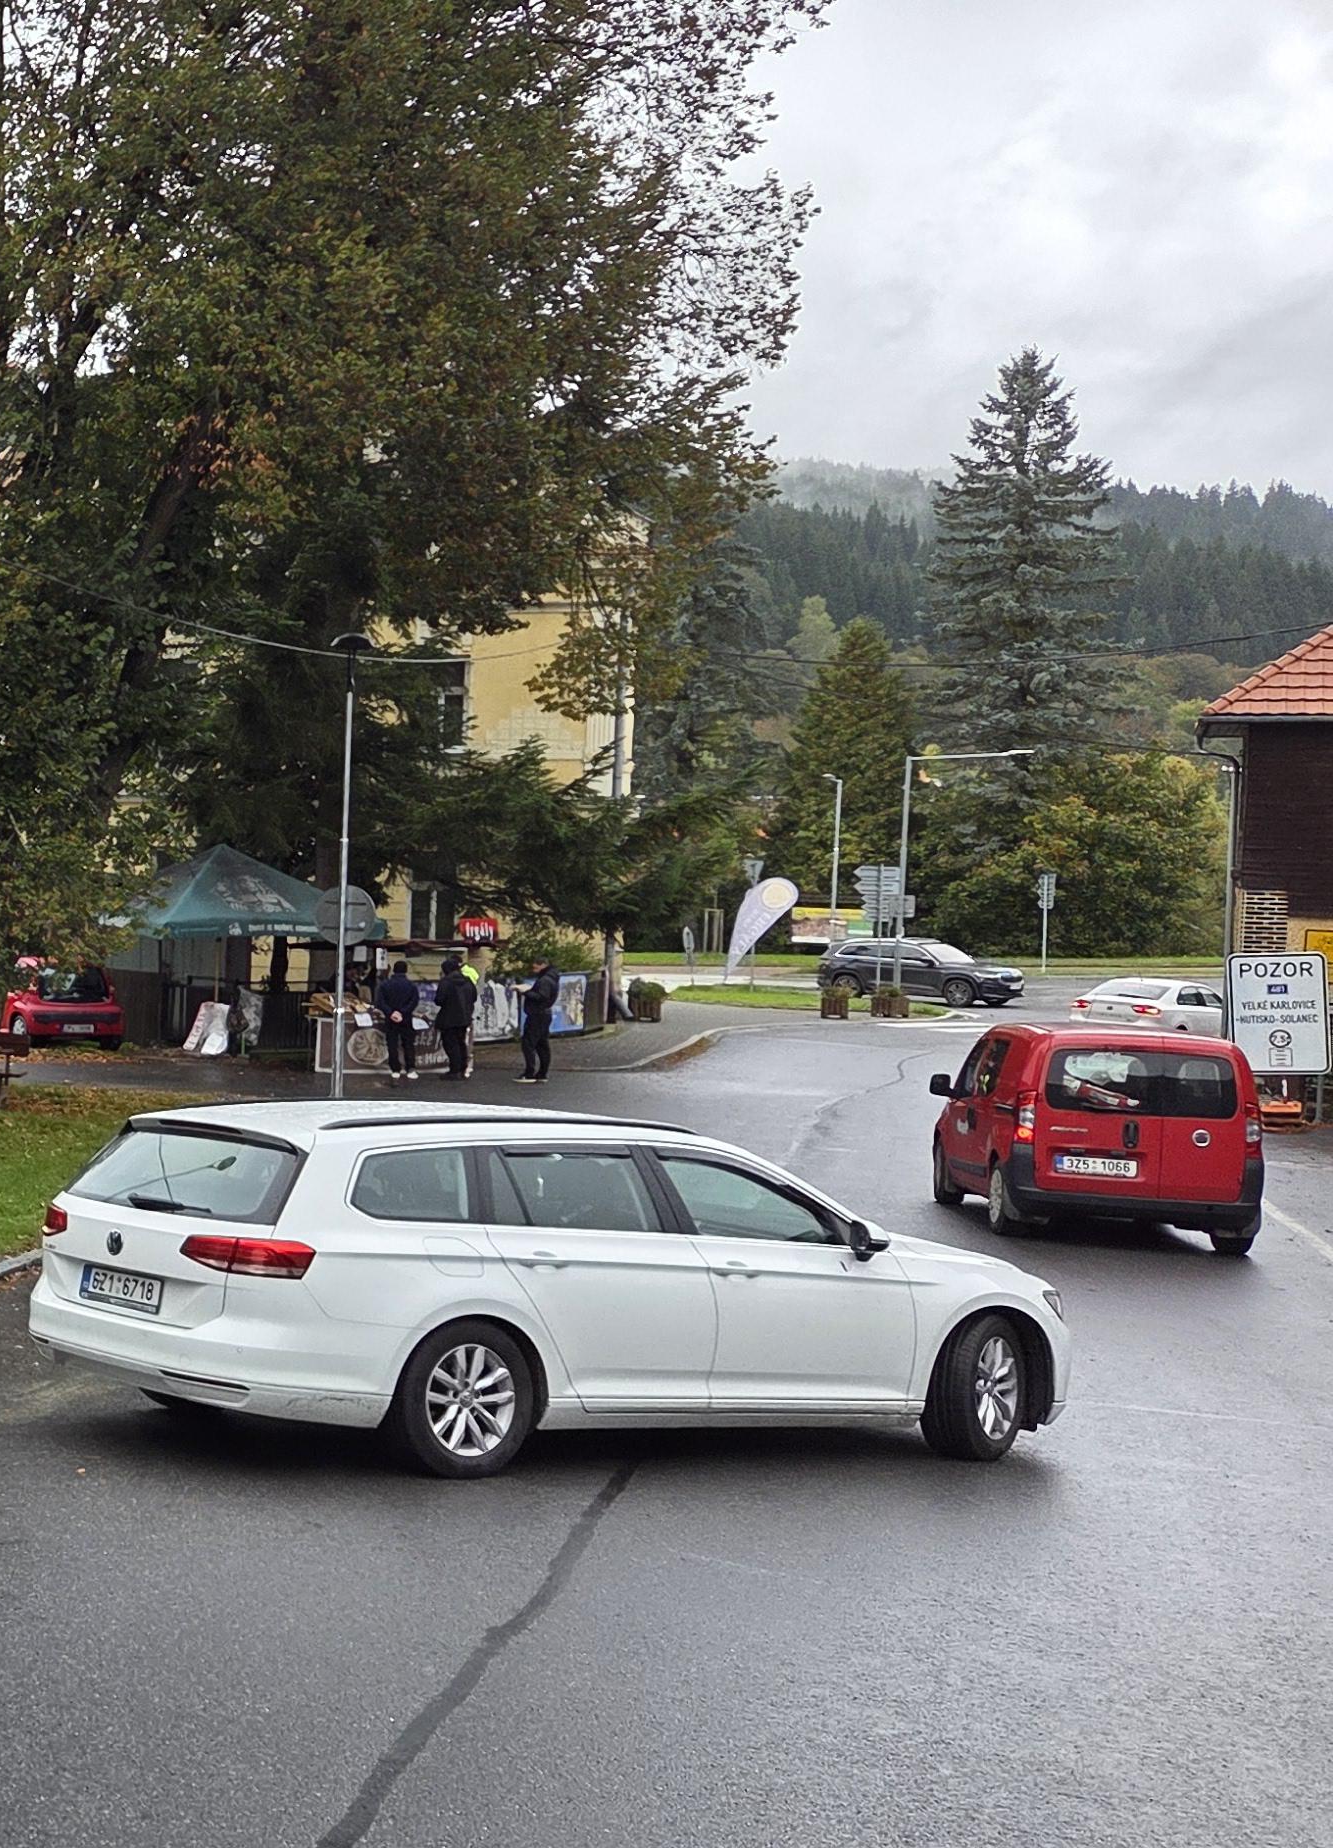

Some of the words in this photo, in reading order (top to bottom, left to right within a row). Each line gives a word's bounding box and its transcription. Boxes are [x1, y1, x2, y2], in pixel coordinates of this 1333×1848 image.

[1239, 961, 1314, 978] POZOR
[1241, 1000, 1268, 1010] VELKÉ
[1270, 1000, 1317, 1010] KARLOVICE
[1066, 1157, 1090, 1170] 3Z5
[1101, 1160, 1131, 1173] 1066
[92, 1271, 115, 1293] 6Z1
[122, 1277, 154, 1300] 6718
